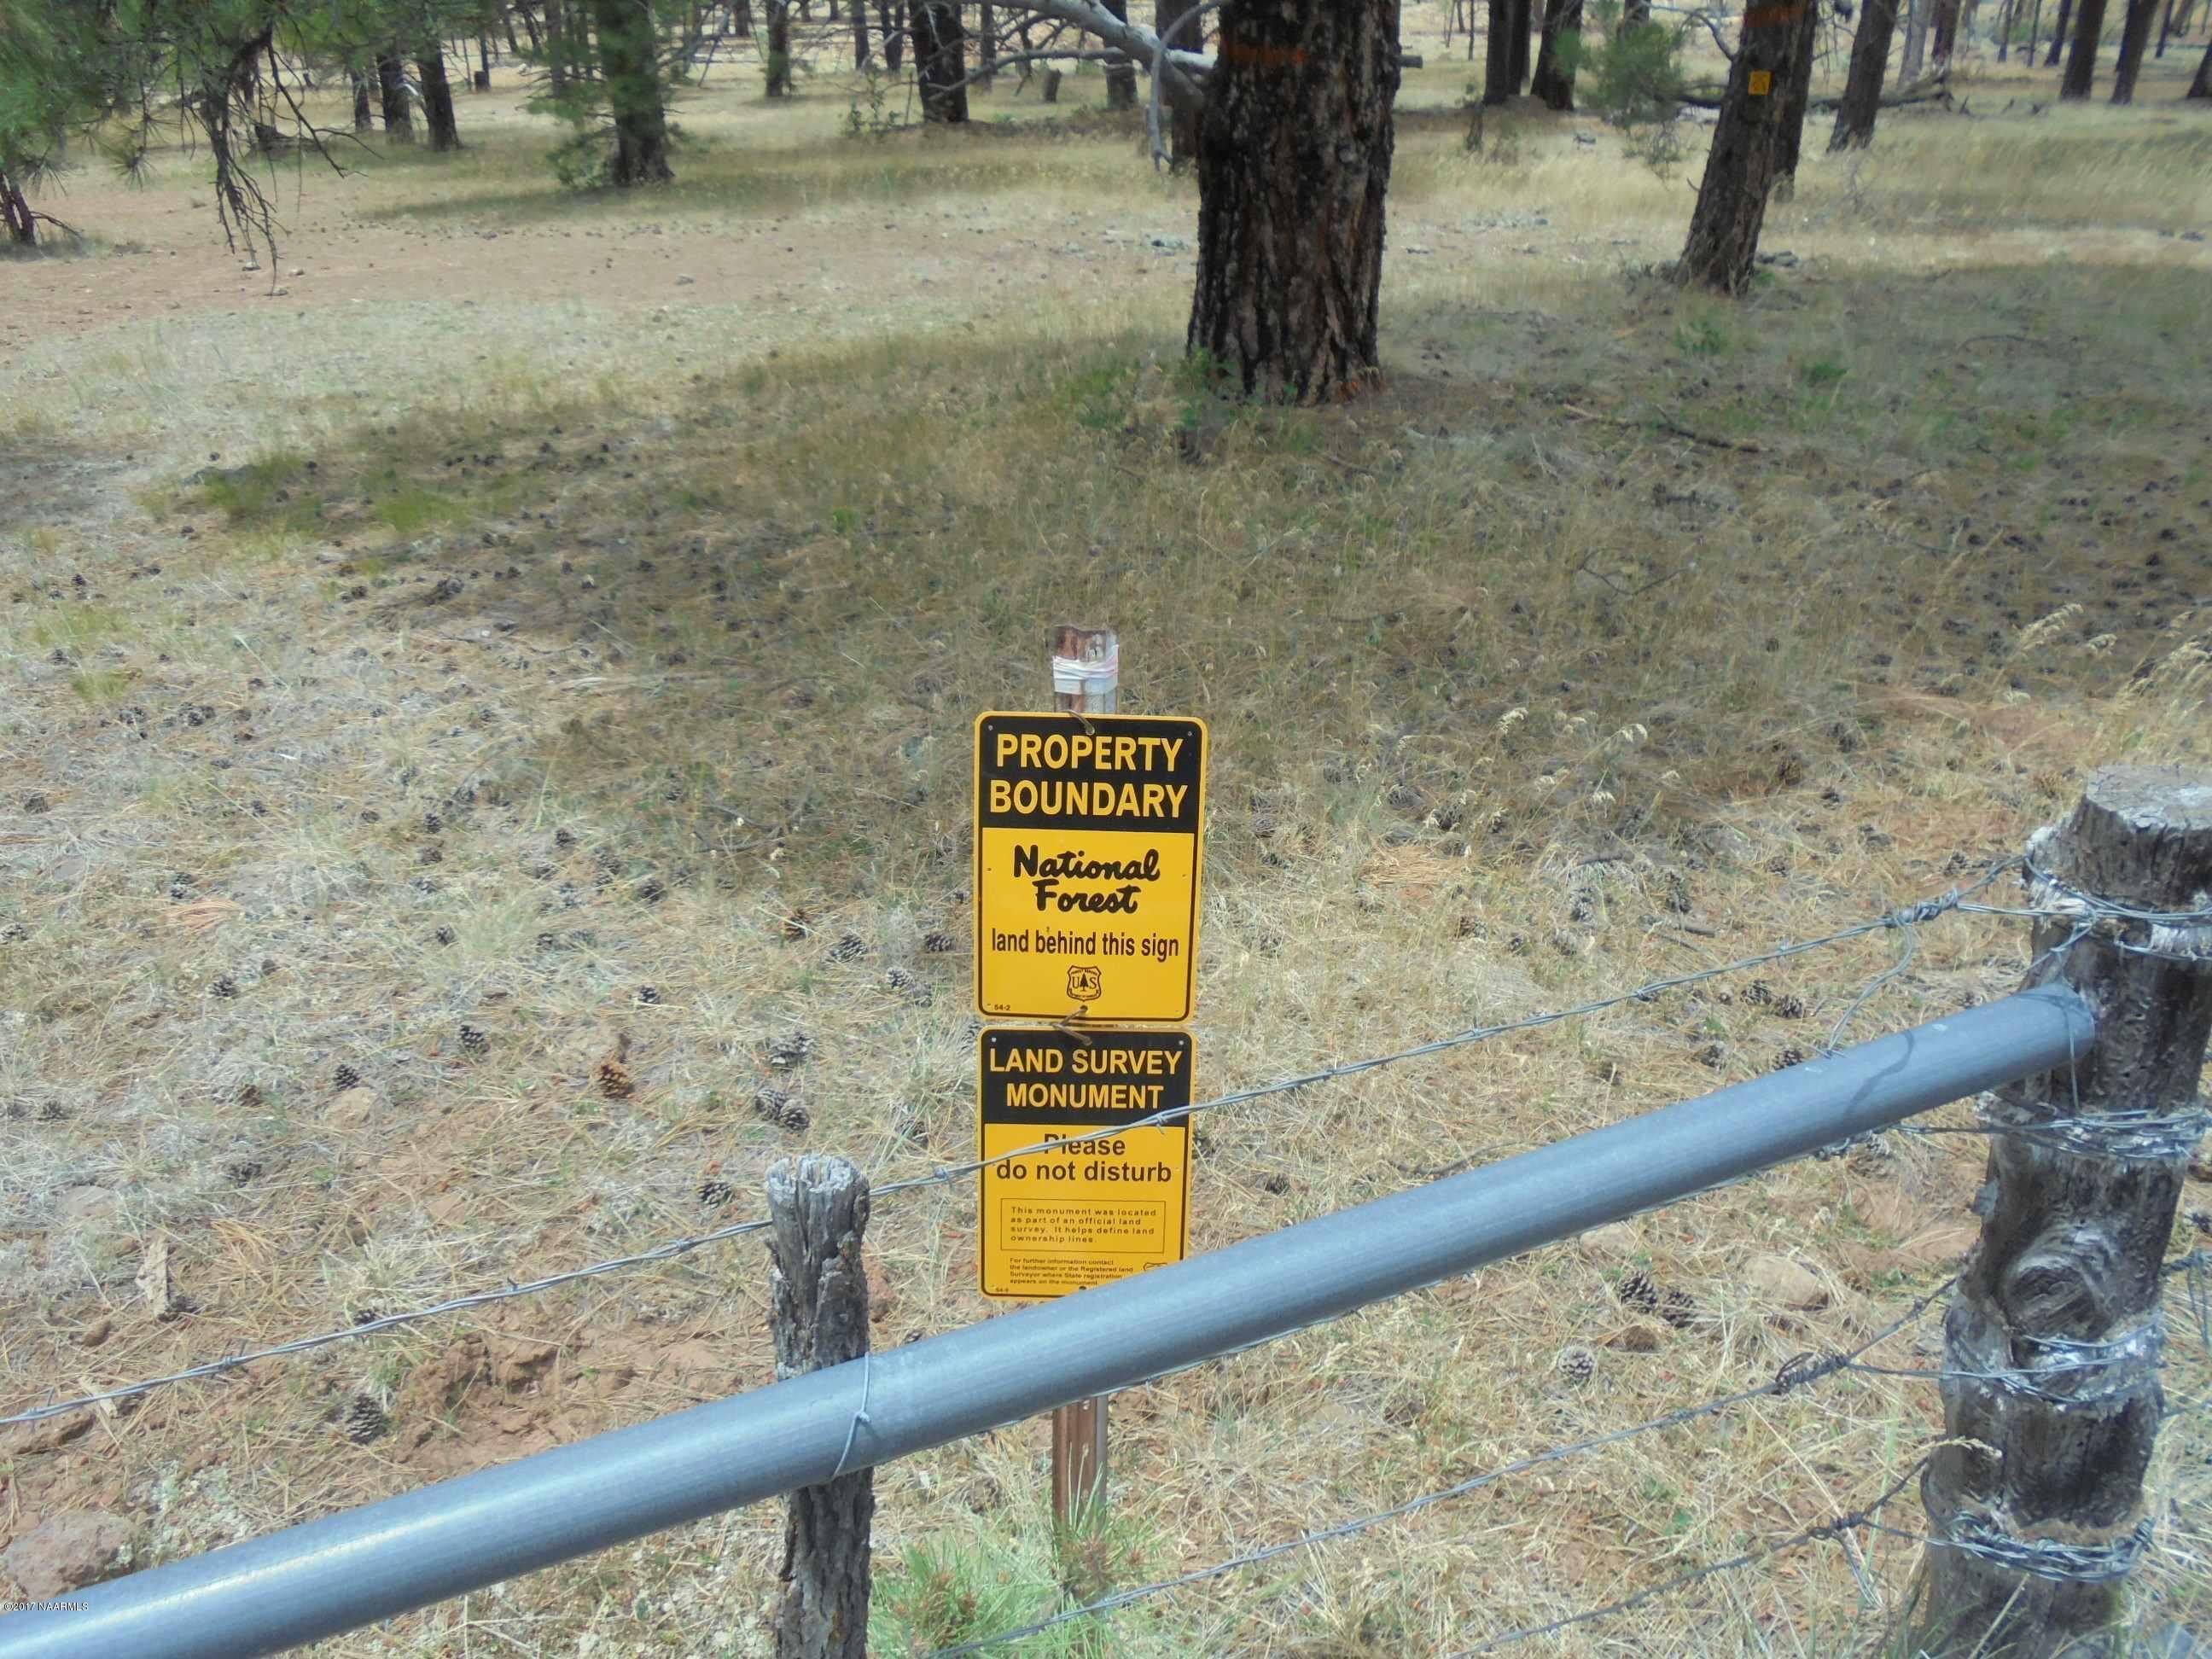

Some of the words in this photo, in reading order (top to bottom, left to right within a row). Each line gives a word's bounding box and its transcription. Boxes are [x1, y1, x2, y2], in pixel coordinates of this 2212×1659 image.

[996, 733, 1184, 772] PROPERTY
[990, 779, 1189, 818] BOUNDARY
[1013, 844, 1161, 882] National
[1032, 878, 1142, 914] Forest
[992, 928, 1029, 953] land
[1035, 929, 1096, 956] behind
[1102, 932, 1135, 957] this
[1141, 936, 1179, 963] sign
[989, 1047, 1063, 1073] LAND
[1071, 1049, 1183, 1074] SURVEY
[1006, 1083, 1164, 1109] MONUMENT
[1044, 1133, 1126, 1155] Please
[996, 1159, 1027, 1180] do
[1036, 1161, 1076, 1181] not
[1084, 1161, 1172, 1183] disturb
[1011, 1206, 1033, 1214] This
[1065, 1226, 1093, 1235] helps
